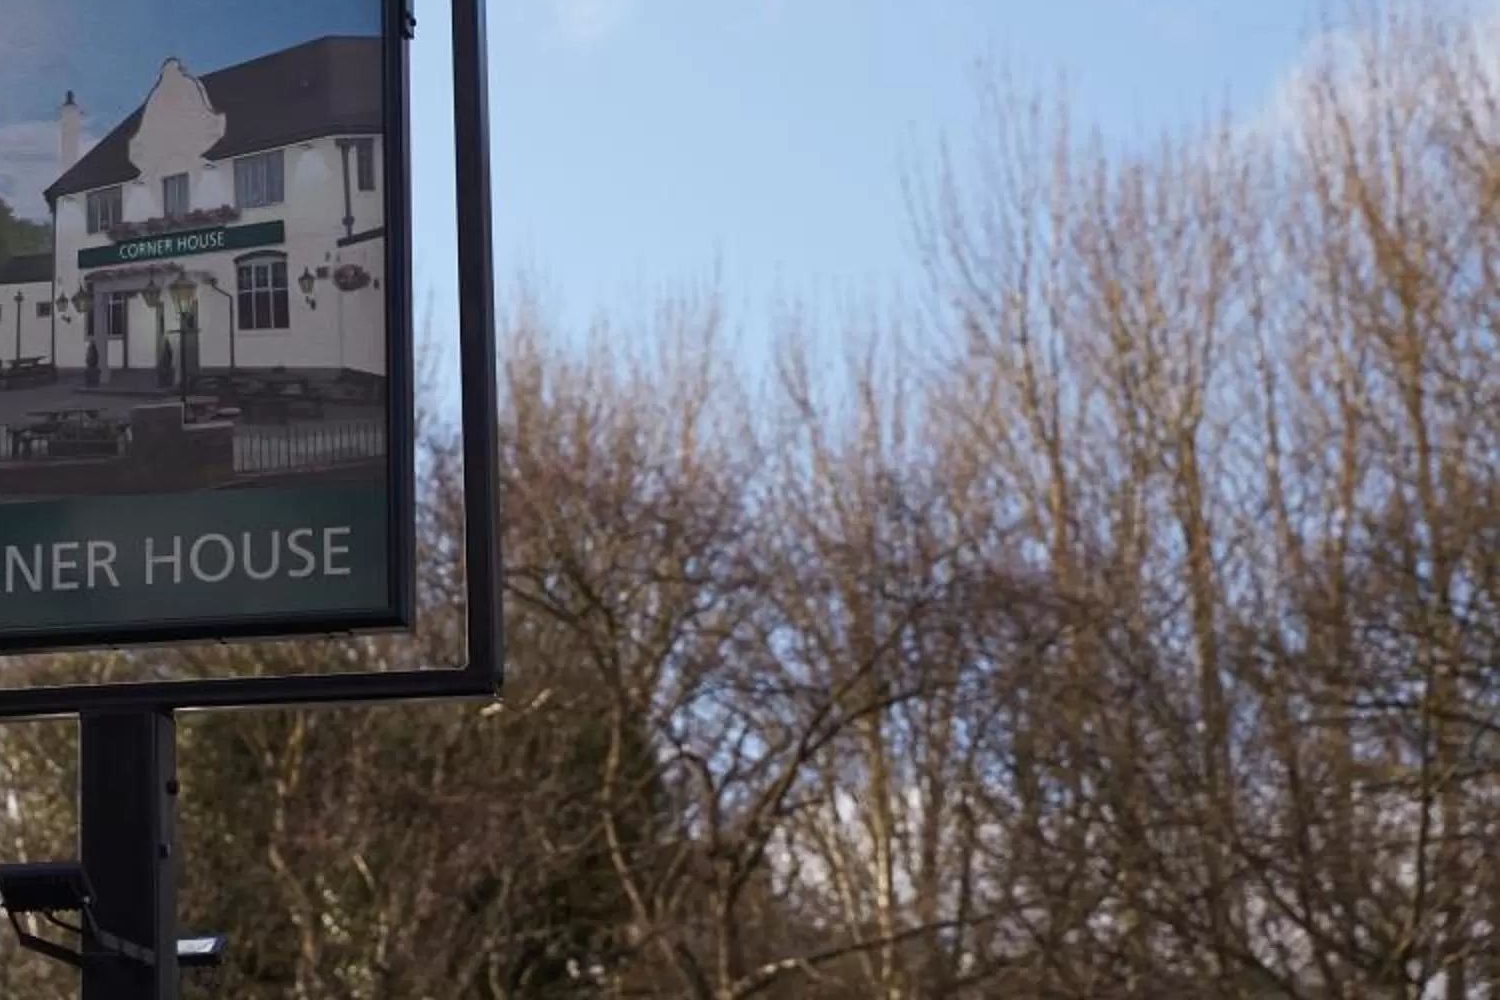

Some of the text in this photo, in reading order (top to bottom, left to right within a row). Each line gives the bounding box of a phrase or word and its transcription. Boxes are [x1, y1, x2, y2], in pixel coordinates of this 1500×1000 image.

[119, 231, 225, 260] CORNER HOUSE
[144, 526, 352, 586] HOUSE
